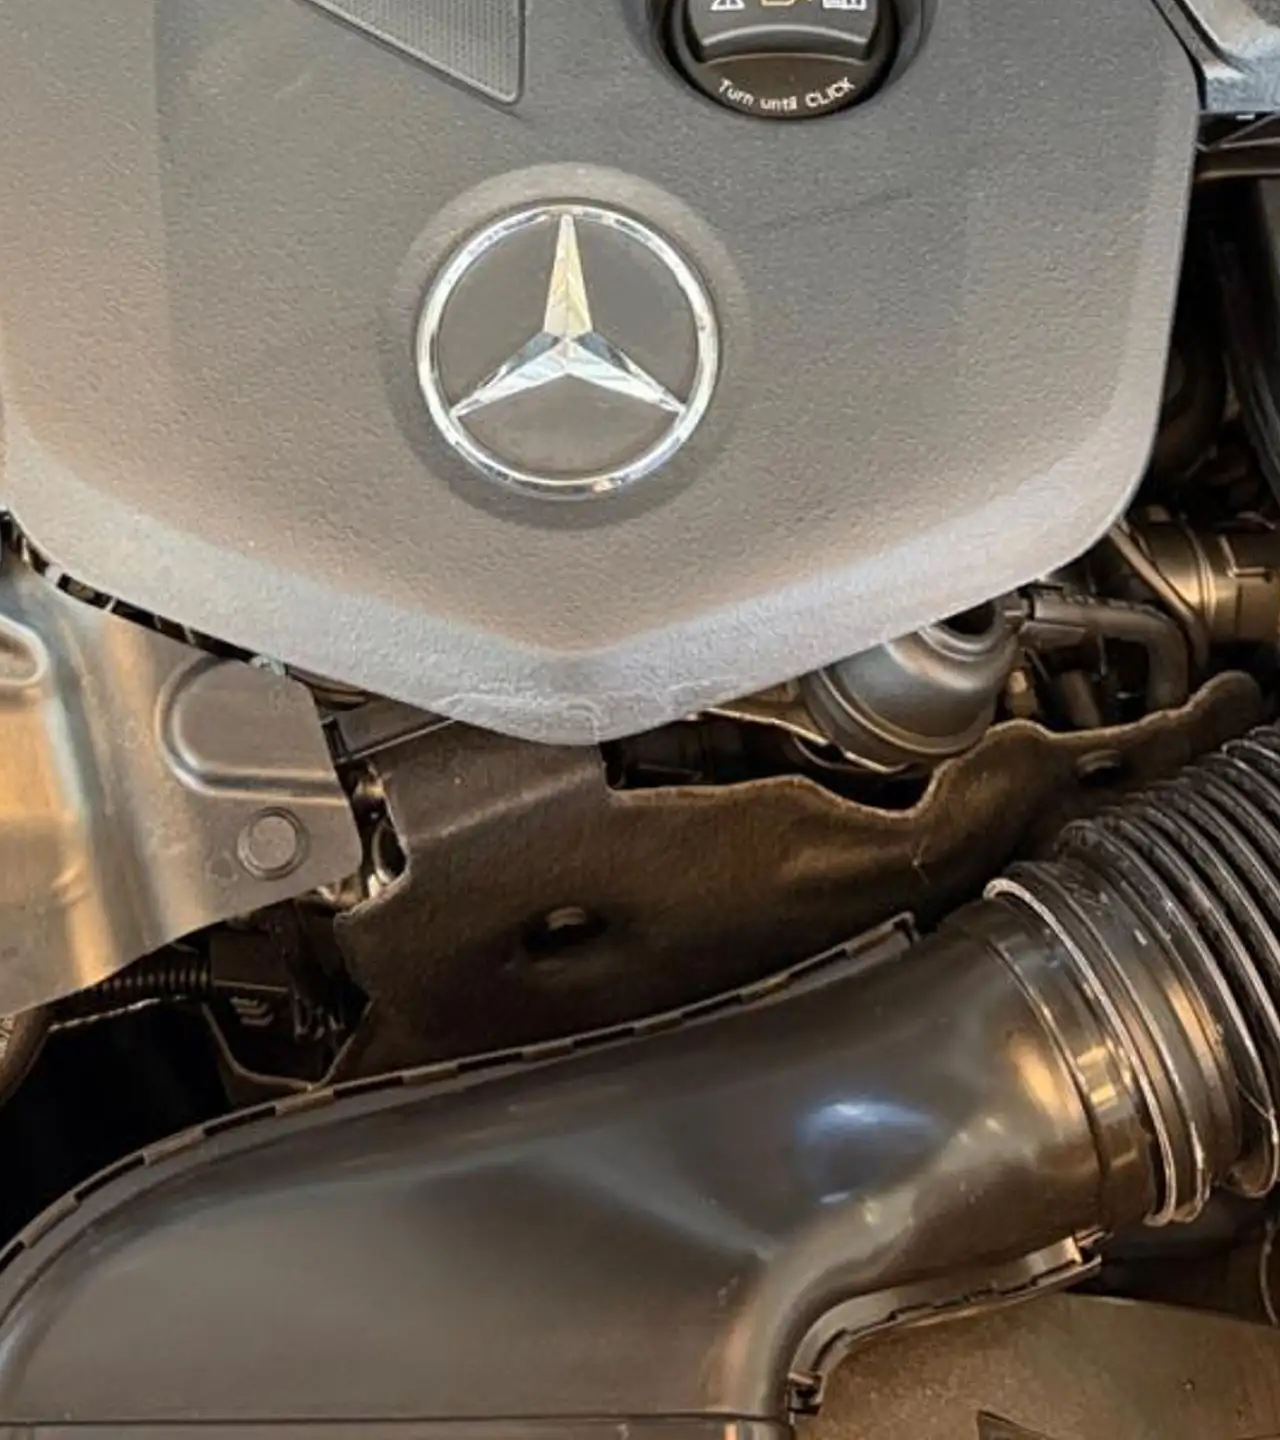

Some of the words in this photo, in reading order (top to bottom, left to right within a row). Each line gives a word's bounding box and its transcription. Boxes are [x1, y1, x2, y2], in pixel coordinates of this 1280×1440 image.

[718, 77, 755, 107] Turn
[760, 95, 798, 112] until
[805, 76, 856, 109] CLICK
